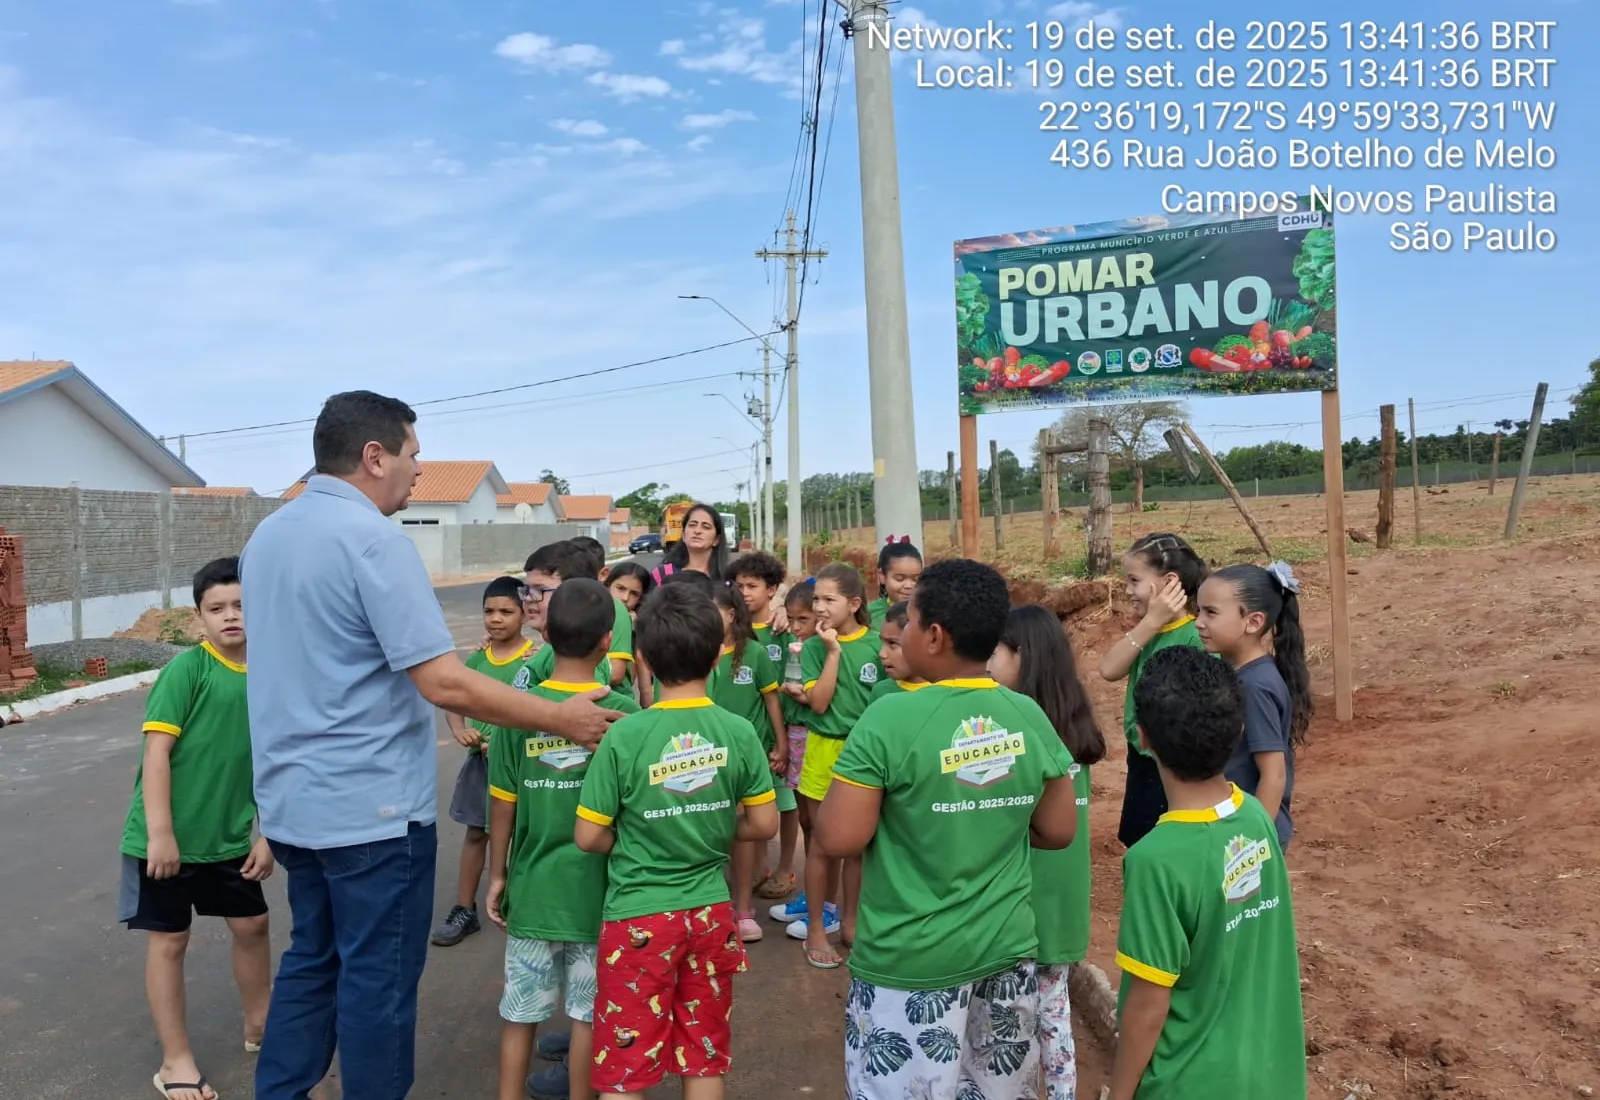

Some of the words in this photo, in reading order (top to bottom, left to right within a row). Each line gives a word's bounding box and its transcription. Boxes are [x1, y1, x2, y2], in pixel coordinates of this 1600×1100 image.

[1281, 213, 1320, 227] CDHU
[1041, 243, 1097, 256] PROGRAMA
[1100, 234, 1154, 249] MUNICÍPIO
[1157, 229, 1190, 242] VERDE
[1194, 229, 1200, 238] E
[1203, 226, 1229, 237] AZUL
[998, 251, 1155, 301] POMAR
[1000, 275, 1273, 347] URBANO
[528, 739, 578, 751] EDUCA
[944, 739, 1021, 766] EDUCAÇÃO
[652, 752, 724, 778] EDUCAÇÃO
[523, 778, 556, 789] GESTÃO
[931, 799, 976, 813] GESTÃO
[978, 795, 1035, 810] 2025/2028
